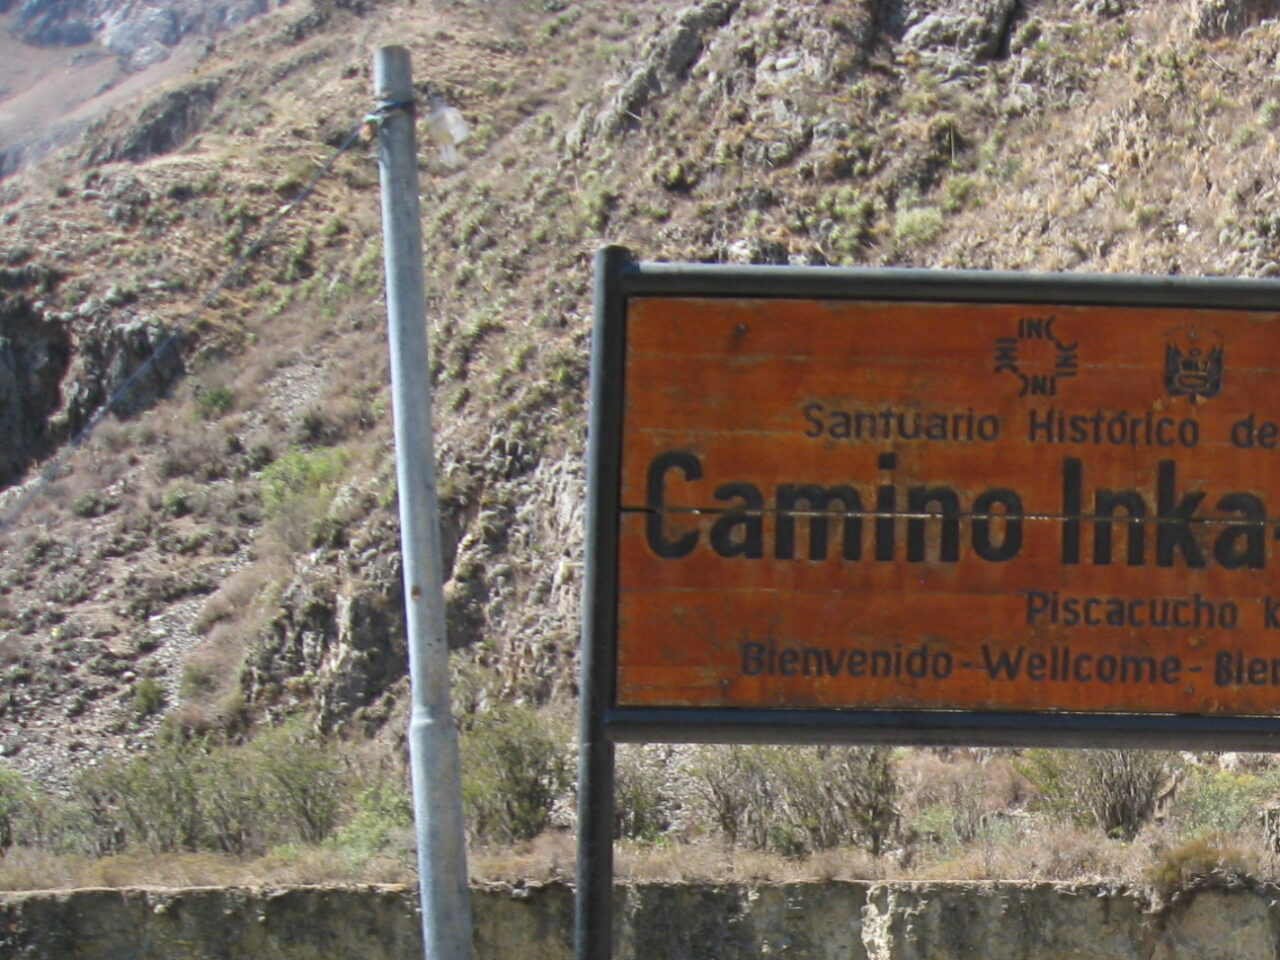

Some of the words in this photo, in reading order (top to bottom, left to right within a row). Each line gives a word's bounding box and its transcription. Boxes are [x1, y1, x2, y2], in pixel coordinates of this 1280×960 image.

[802, 404, 1000, 442] Santuario
[1028, 408, 1201, 448] Histórico
[1230, 415, 1280, 450] de
[645, 449, 1024, 564] Camino
[1024, 590, 1239, 630] Piscacucho
